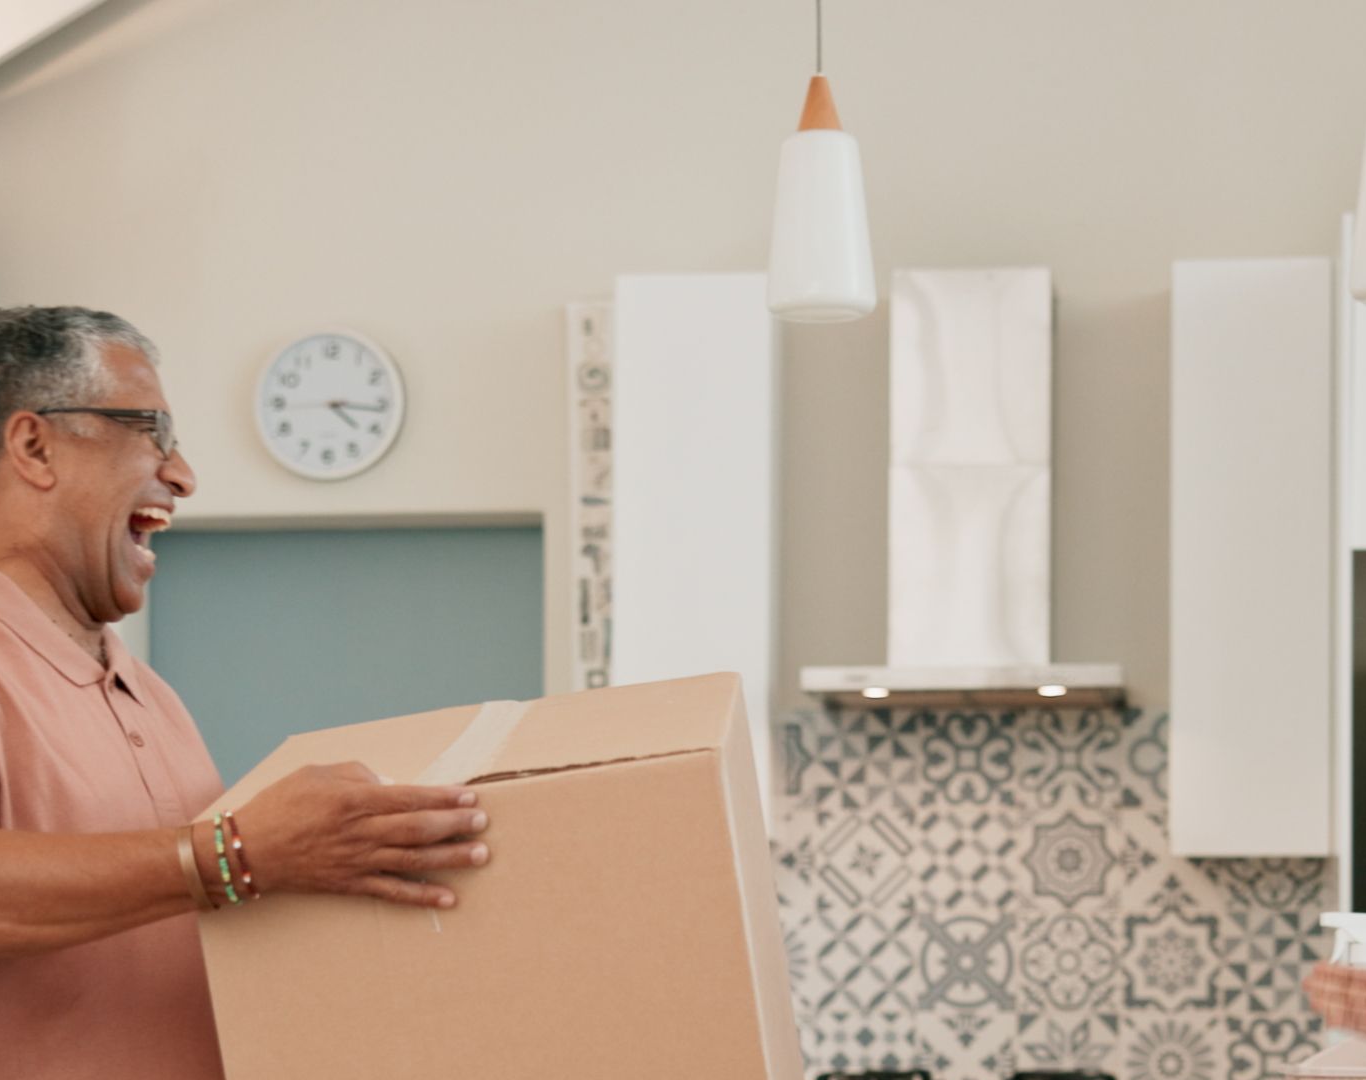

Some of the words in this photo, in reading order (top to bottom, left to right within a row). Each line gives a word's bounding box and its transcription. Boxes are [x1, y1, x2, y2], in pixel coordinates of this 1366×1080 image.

[322, 341, 340, 360] 12
[280, 372, 300, 389] 10
[274, 394, 286, 412] 9
[278, 420, 291, 438] 8
[320, 447, 334, 466] 6
